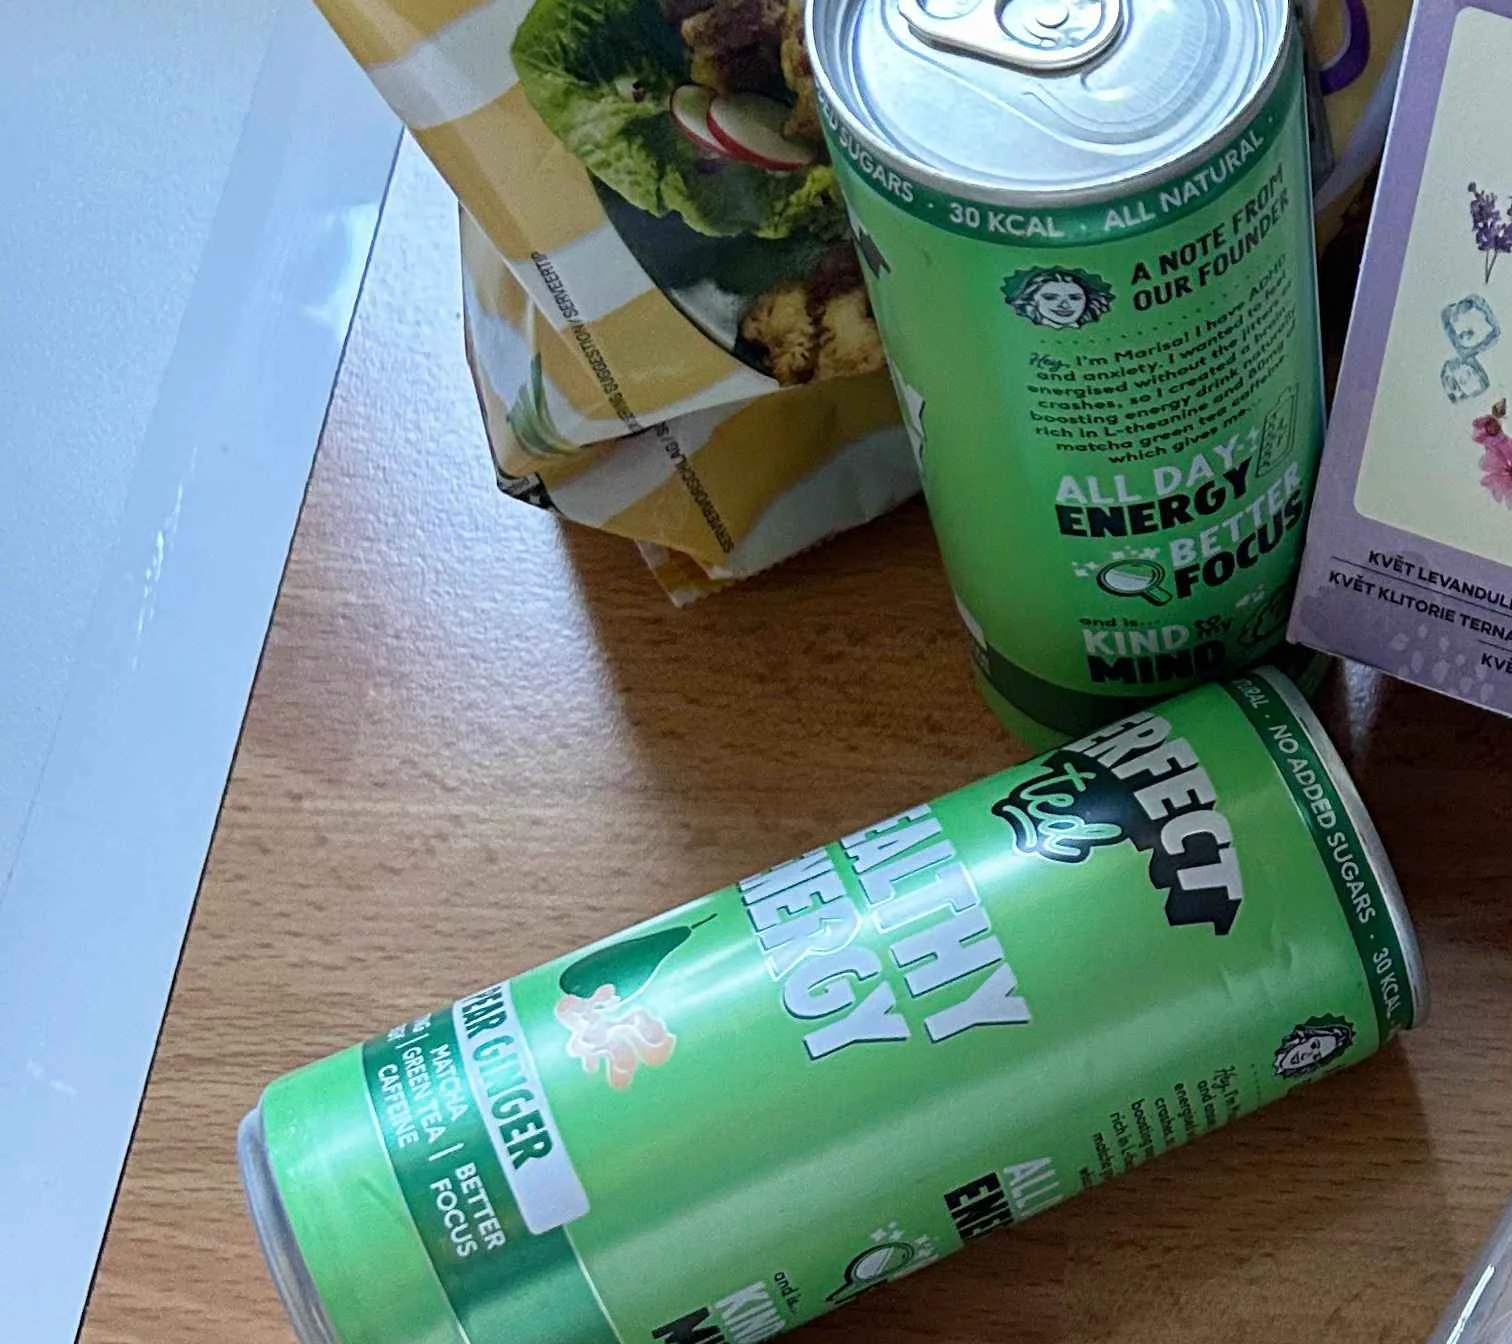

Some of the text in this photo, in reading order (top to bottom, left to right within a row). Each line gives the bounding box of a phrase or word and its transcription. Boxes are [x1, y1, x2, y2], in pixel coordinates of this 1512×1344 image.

[839, 126, 1066, 239] SUGARS 30 KCAL
[1103, 129, 1264, 232] ALL NATURAL
[1130, 162, 1284, 286] A NOTE FROM
[1132, 187, 1290, 312] OUR FOUNDER
[1027, 358, 1207, 399] energised without
[1076, 355, 1109, 367] I'm
[1030, 395, 1192, 426] boosting energy
[1055, 422, 1194, 452] matcha green
[1055, 434, 1238, 505] ALL DAY
[1055, 455, 1253, 538] ENERGY
[1169, 461, 1302, 568] BETTER
[1173, 488, 1305, 600] FOCUS
[1329, 571, 1376, 595] KVĚT
[1378, 586, 1456, 623] KLITORIE
[1368, 550, 1415, 576] KVĚT
[1082, 623, 1191, 656] KIND
[1085, 639, 1228, 685] MIND
[1077, 710, 1244, 904] ERFECT
[1269, 725, 1401, 1019] NO ADDED SUGARS 30 KCAL
[737, 848, 911, 1061] NERGY
[840, 803, 1032, 1044] EALTHY
[378, 1064, 419, 1148] CAFFEINE
[402, 1047, 430, 1100] GREEN
[417, 1099, 446, 1143] TEA
[429, 1044, 468, 1121] MATCHA
[461, 985, 554, 1171] PEAR GINGER
[430, 1178, 477, 1257] FOCUS
[455, 1162, 505, 1249] BETTER
